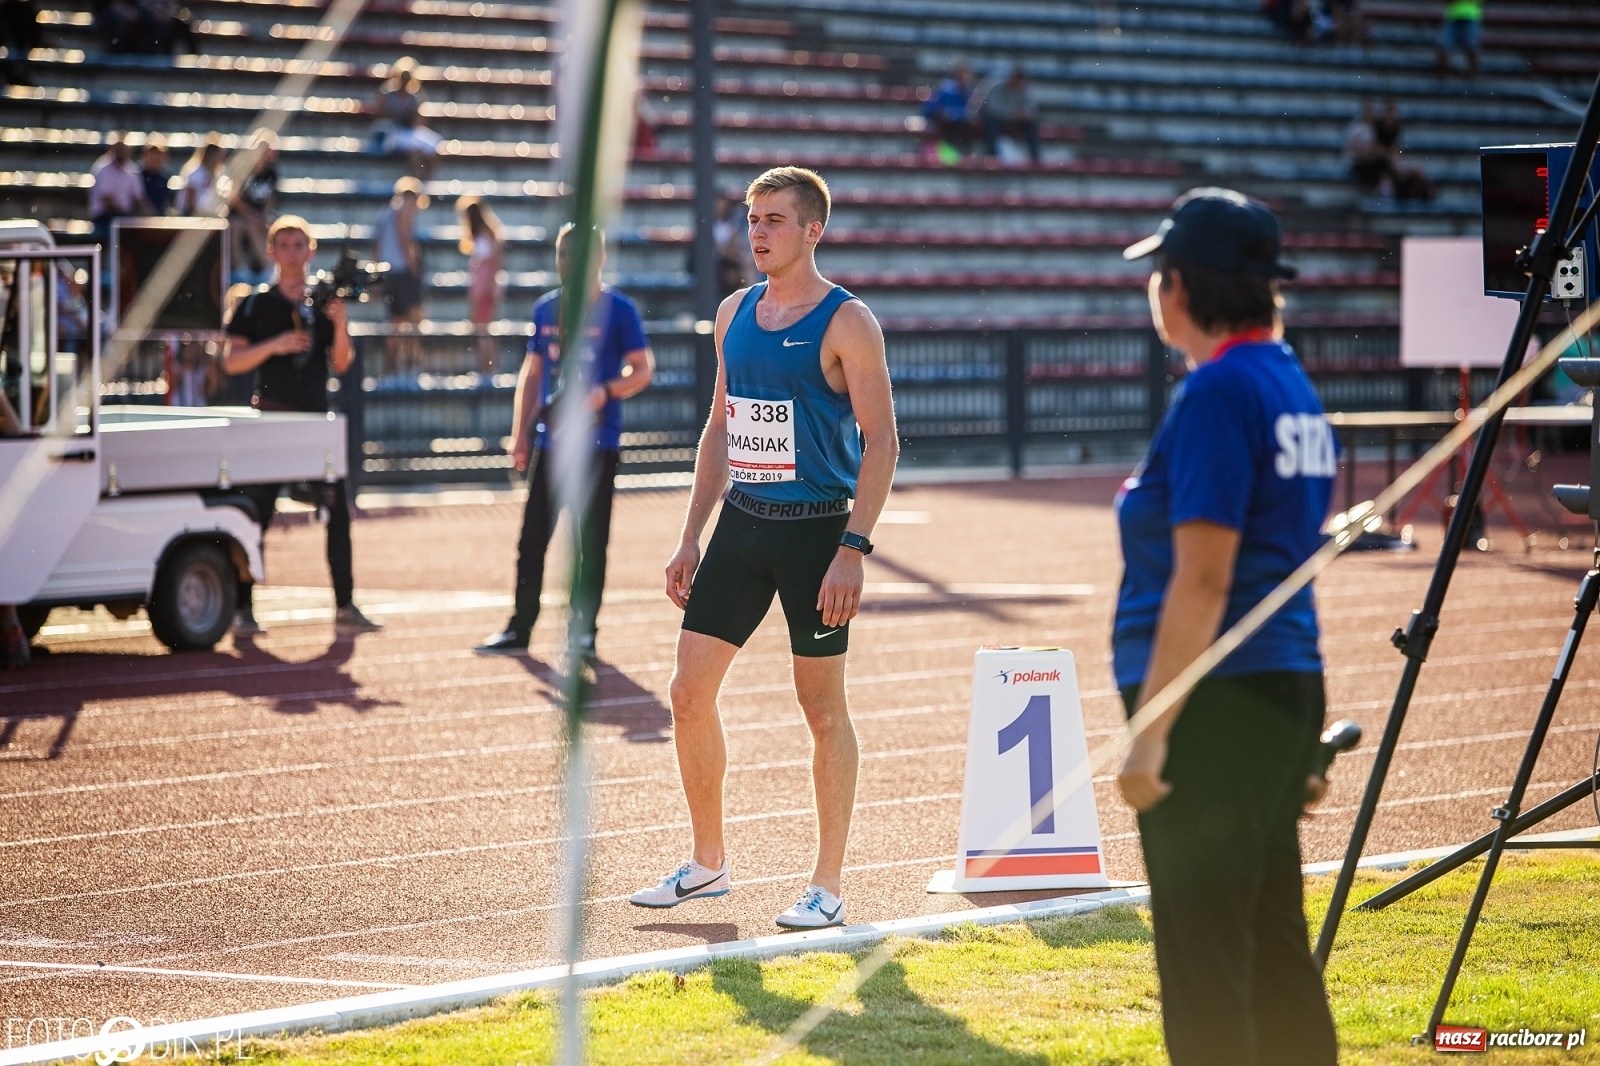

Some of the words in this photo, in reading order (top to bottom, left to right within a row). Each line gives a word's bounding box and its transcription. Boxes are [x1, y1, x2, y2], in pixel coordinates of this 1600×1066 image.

[750, 403, 789, 423] 338
[759, 473, 783, 481] 2019
[738, 492, 767, 515] NIKE
[767, 503, 805, 517] PRO
[808, 498, 846, 515] NIKE
[1012, 668, 1062, 686] polanik
[997, 695, 1055, 834] 1
